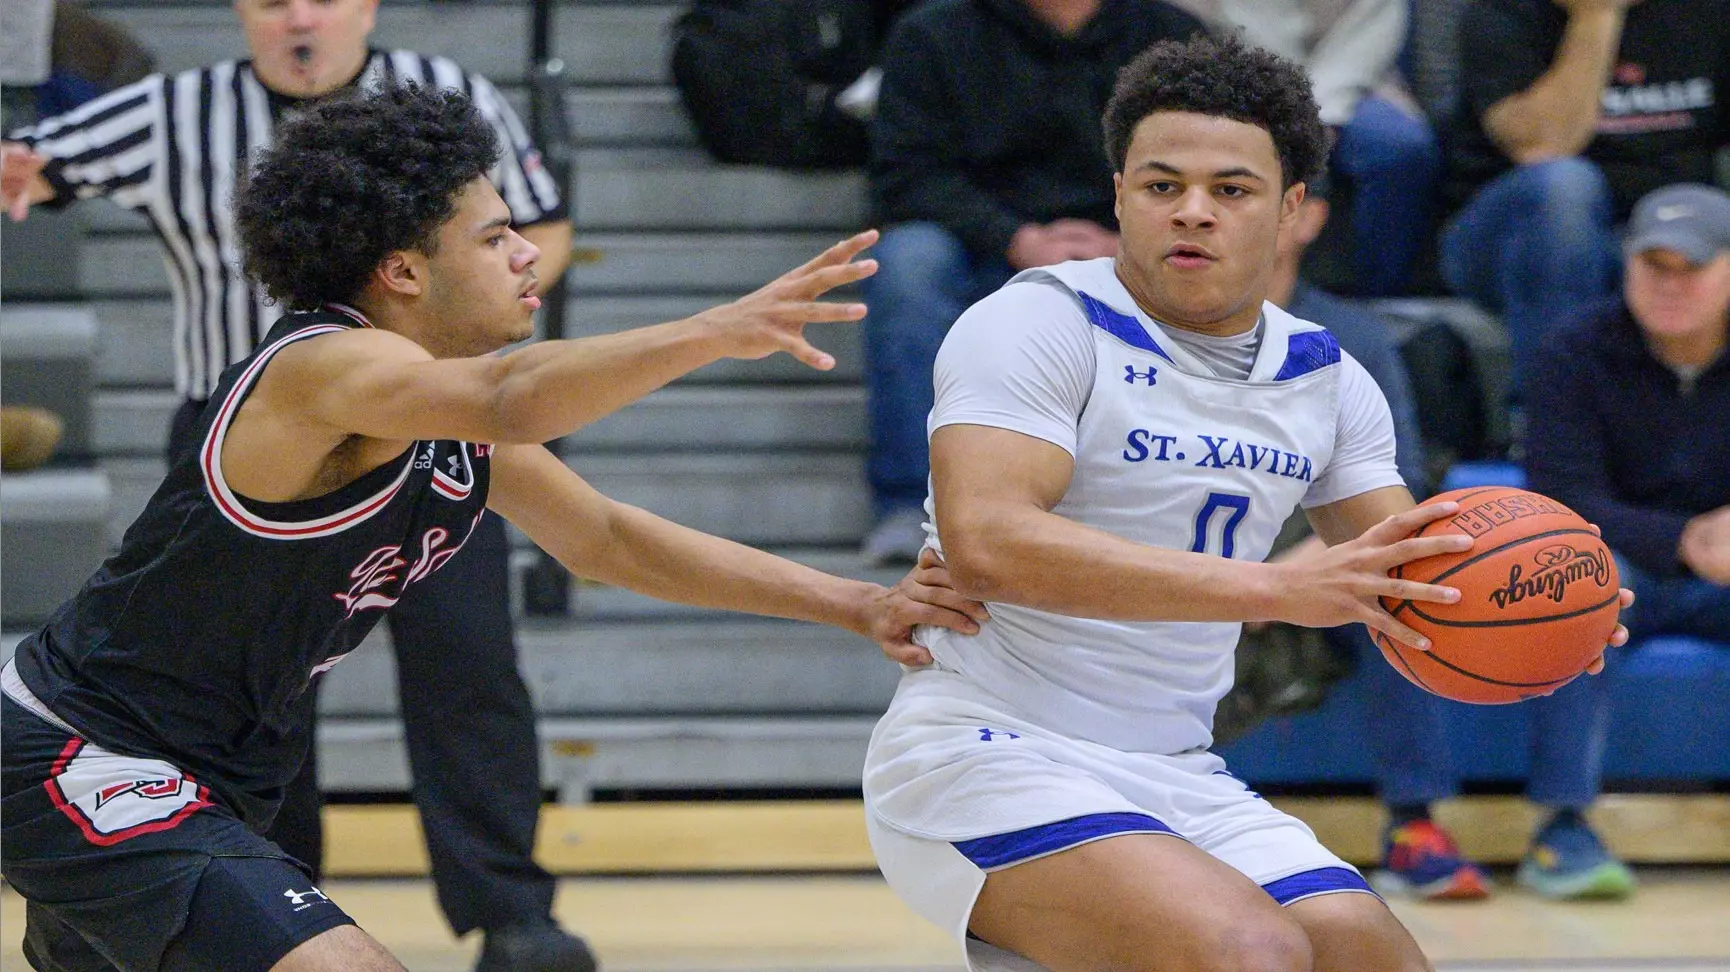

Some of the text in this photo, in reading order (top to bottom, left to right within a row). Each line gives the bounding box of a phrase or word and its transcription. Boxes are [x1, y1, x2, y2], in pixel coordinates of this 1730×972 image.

[1122, 428, 1312, 483] ST. XAVIER
[1488, 547, 1610, 610] Rawlings
